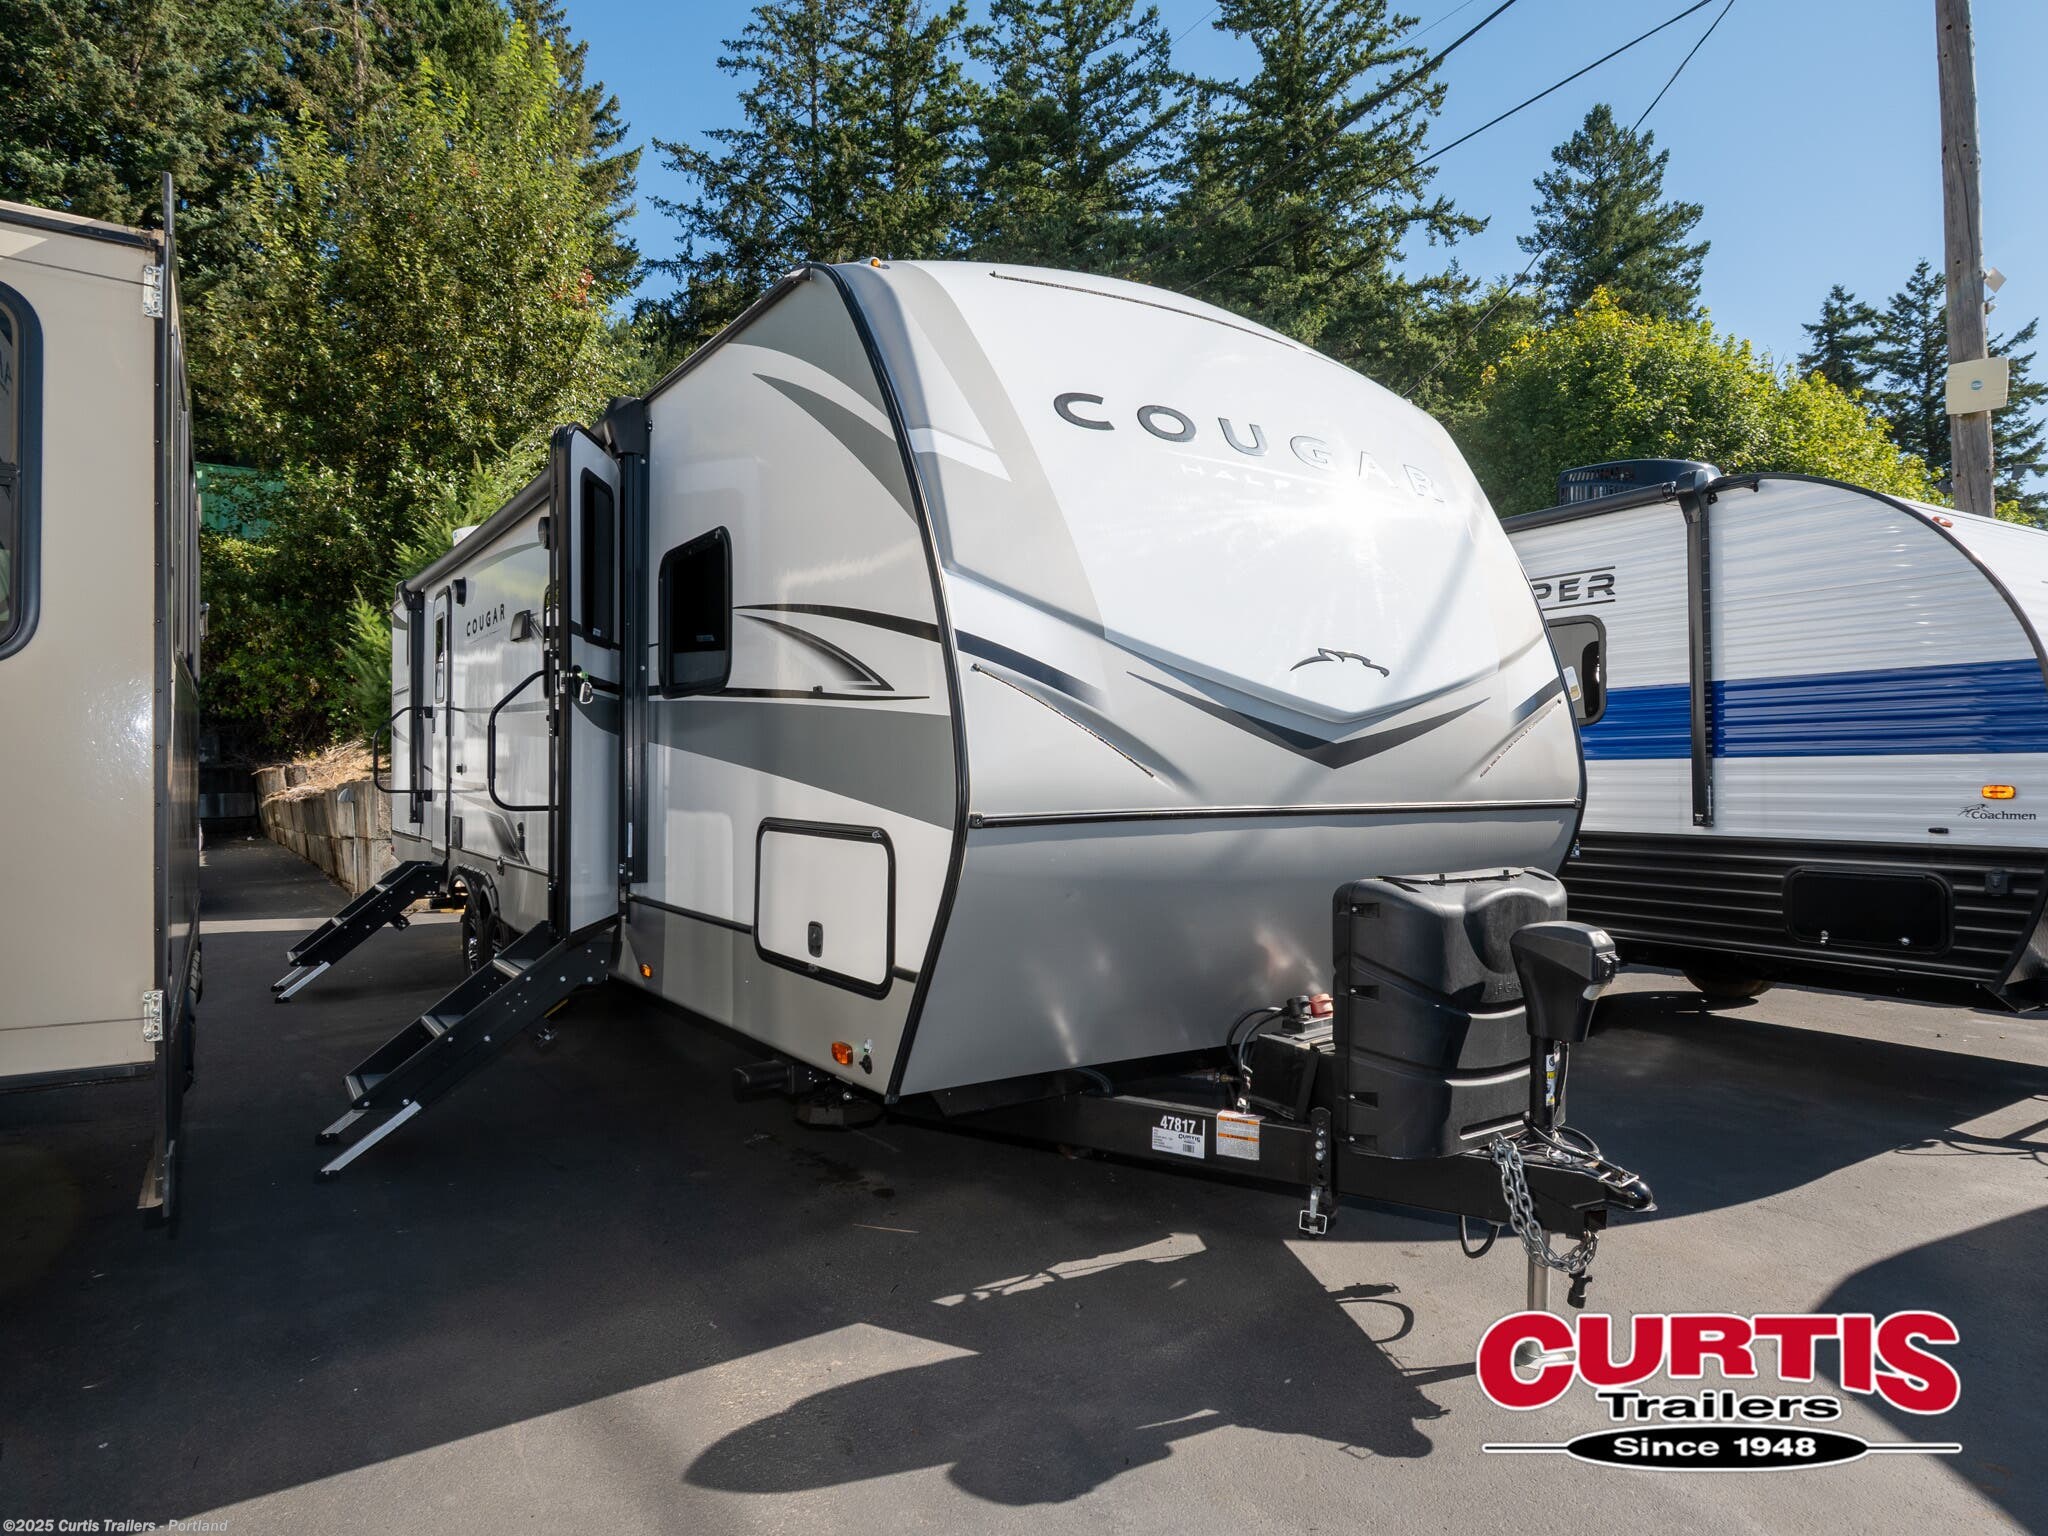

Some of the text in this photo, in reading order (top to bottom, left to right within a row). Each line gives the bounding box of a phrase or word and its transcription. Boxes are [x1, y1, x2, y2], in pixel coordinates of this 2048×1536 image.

[1053, 392, 1446, 503] COUGAR
[466, 603, 505, 637] COUGAR
[1971, 811, 2037, 821] Coachmen
[1160, 1115, 1196, 1134] 47817
